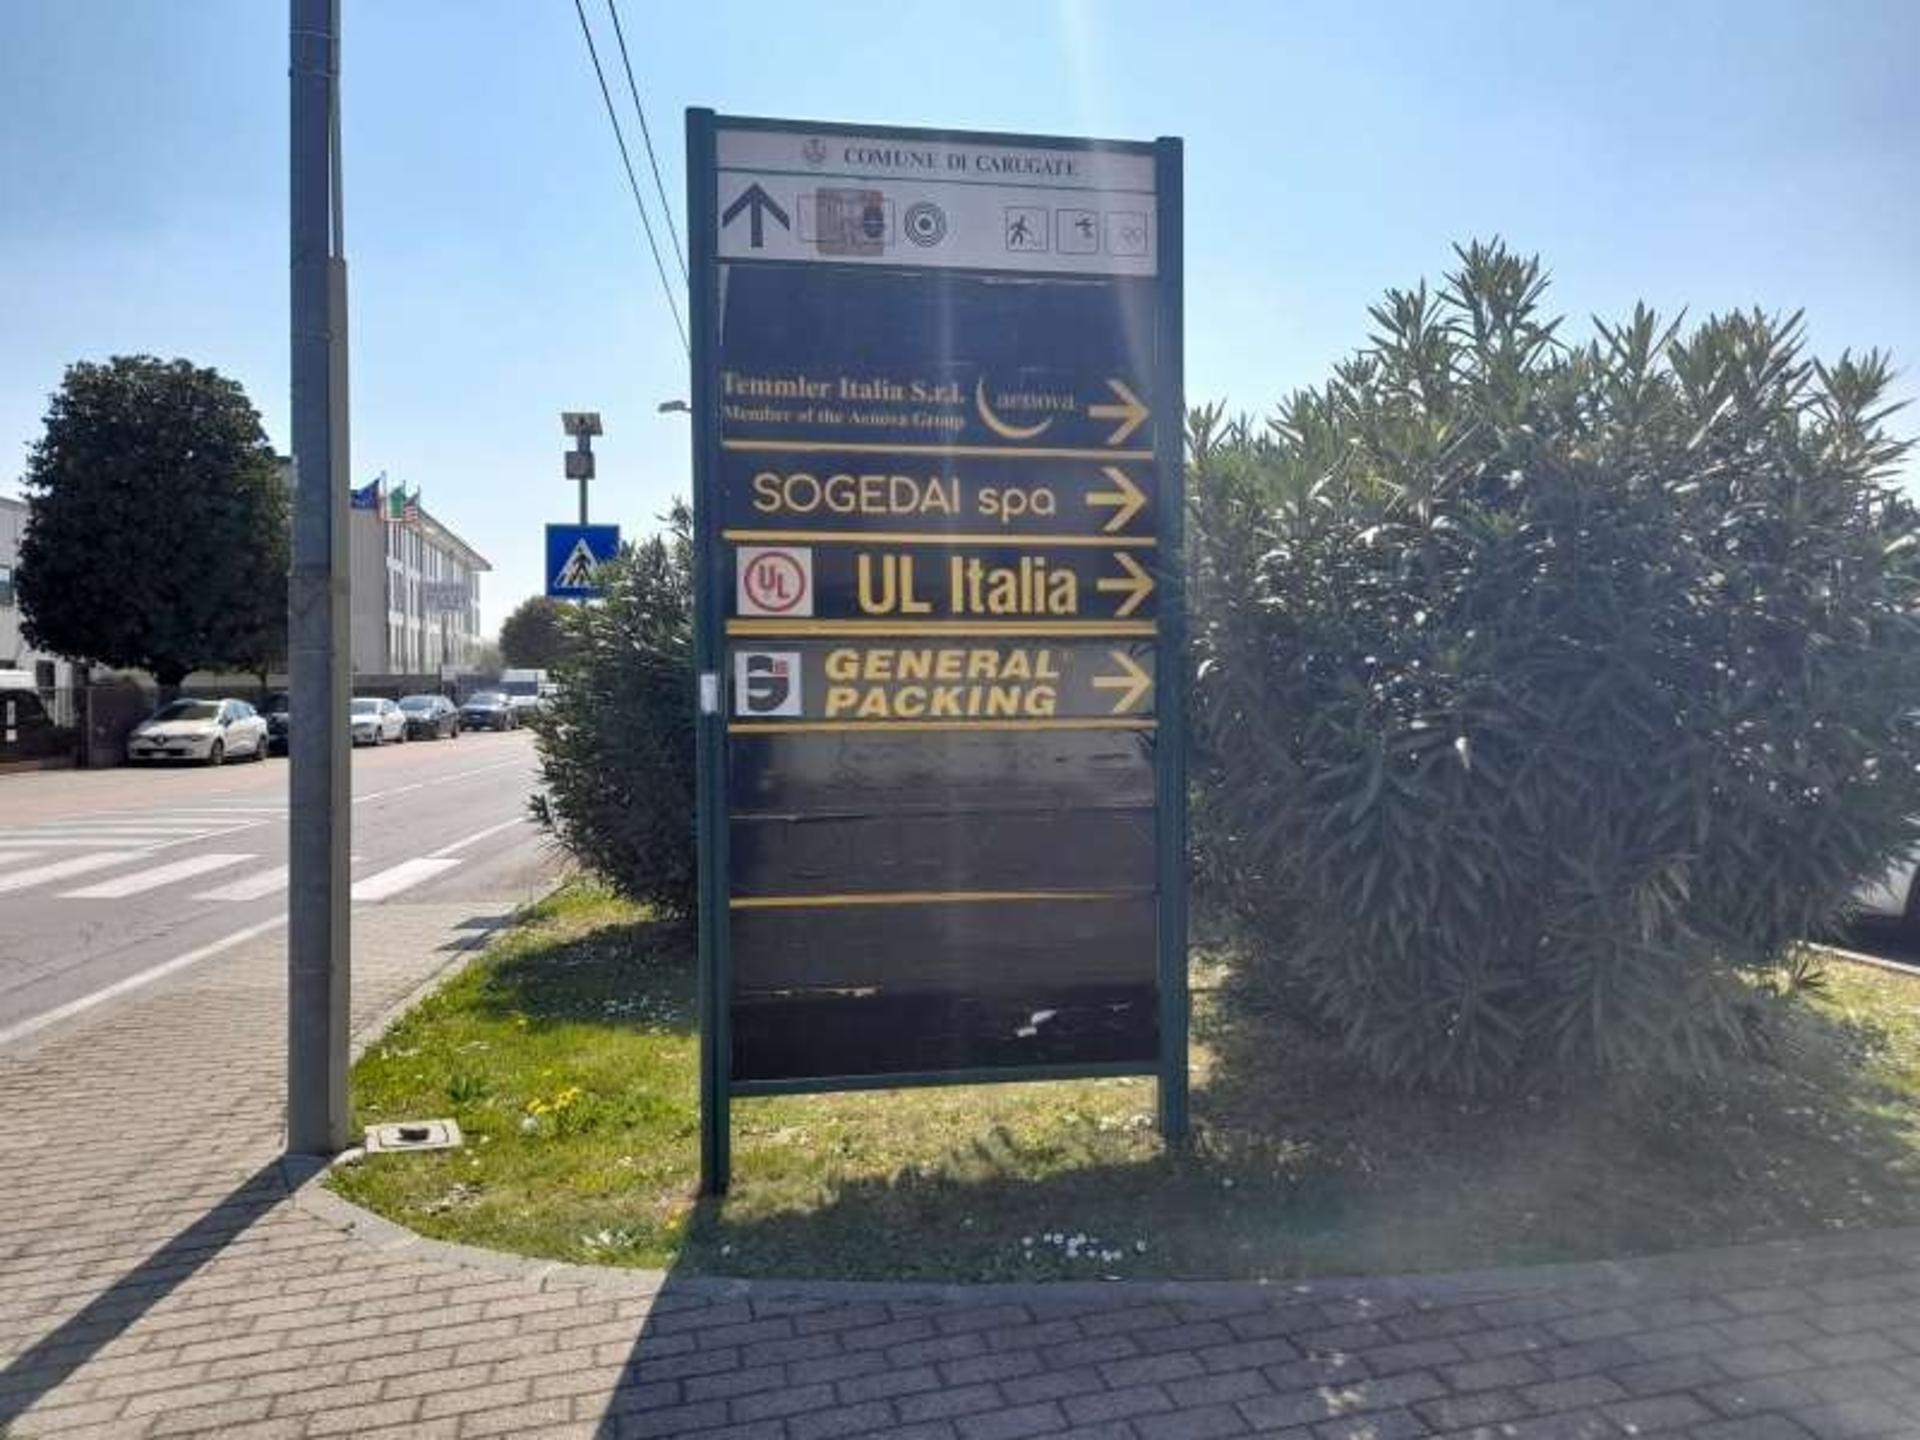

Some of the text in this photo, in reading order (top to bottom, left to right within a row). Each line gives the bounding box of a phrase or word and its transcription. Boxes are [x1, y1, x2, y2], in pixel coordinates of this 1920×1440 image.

[843, 148, 1080, 177] COMUNE DI CARUGATE
[723, 371, 965, 404] Temmler Italia S.r.l.
[723, 404, 791, 423] Member
[798, 406, 813, 423] of
[817, 407, 842, 424] the
[911, 411, 965, 431] Group
[752, 471, 1056, 524] SOGEDAI spa
[857, 553, 1078, 615] UL Italia
[824, 647, 1061, 681] GENERAL
[824, 684, 1057, 718] PACKING
